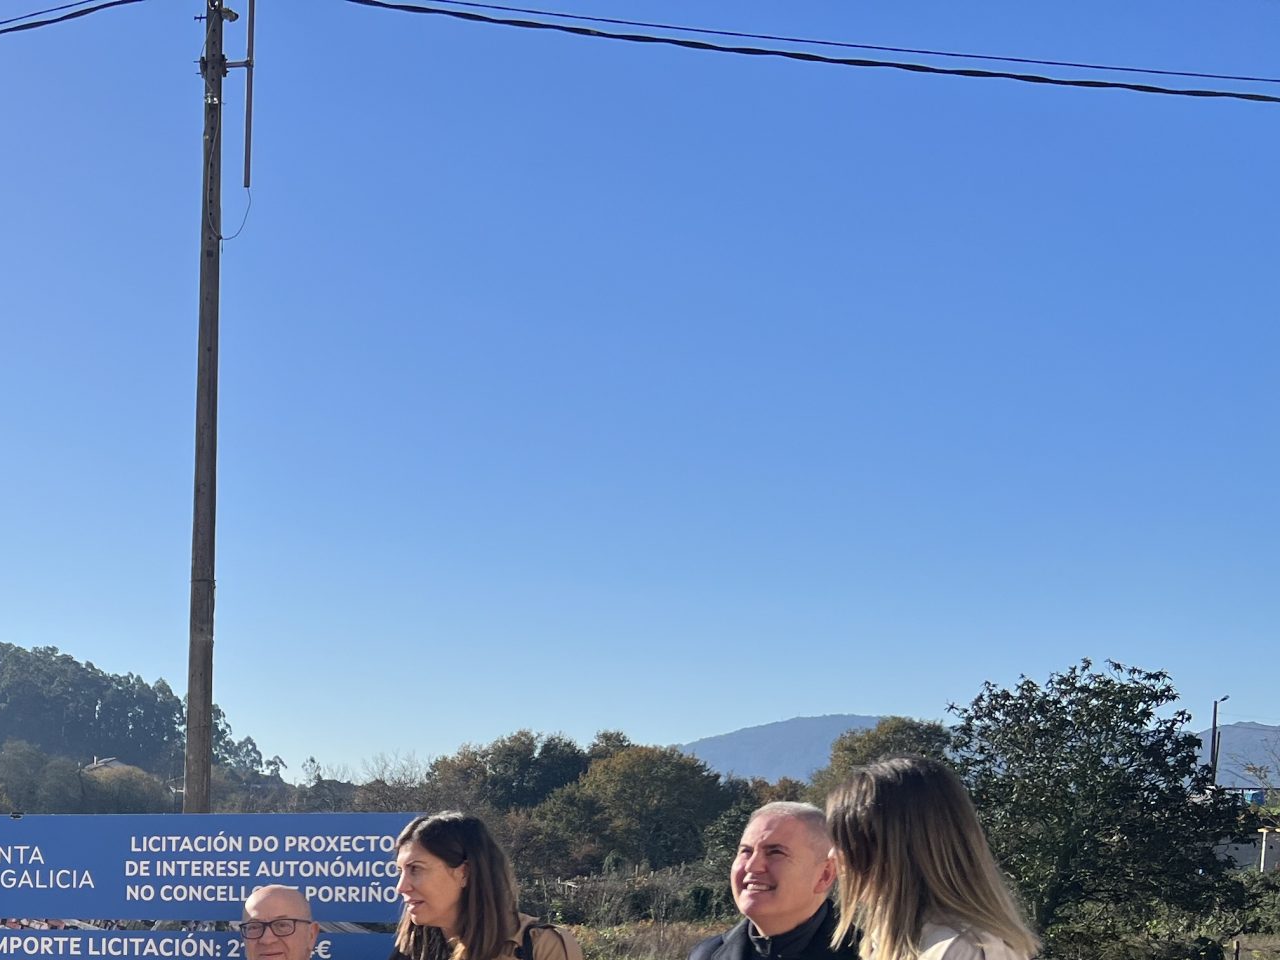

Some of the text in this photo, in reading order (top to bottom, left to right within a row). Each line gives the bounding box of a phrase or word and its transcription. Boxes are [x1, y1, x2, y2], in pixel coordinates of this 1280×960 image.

[131, 830, 395, 853] LICITACIÓN DO PROXECTO
[125, 856, 399, 878] DE INTERESE AUTONÓMICO
[0, 869, 95, 889] GALICIA
[126, 884, 155, 901] NO
[160, 884, 261, 902] CONCELL
[305, 882, 398, 903] PORRIÑO
[88, 933, 221, 957] LICITACIÓN:
